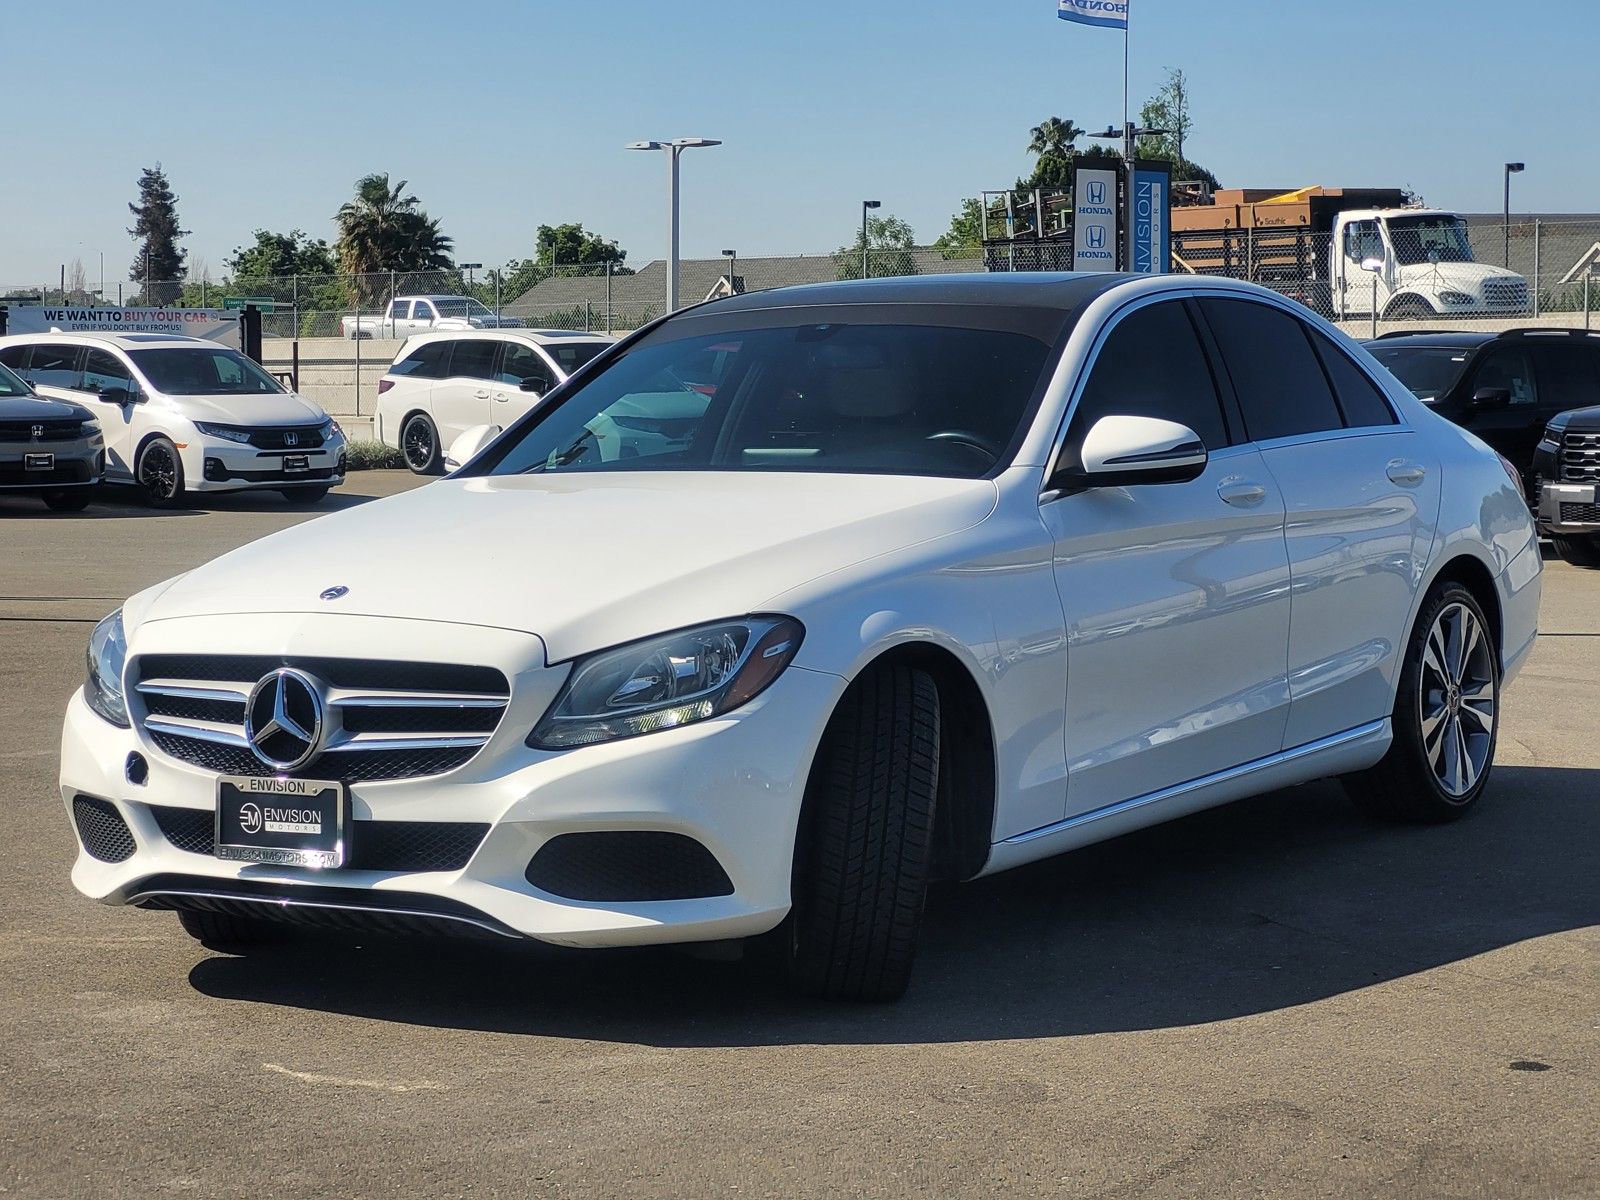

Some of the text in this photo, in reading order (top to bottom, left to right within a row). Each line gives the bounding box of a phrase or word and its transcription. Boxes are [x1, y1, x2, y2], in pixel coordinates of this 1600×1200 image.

[1078, 206, 1113, 215] HONDA
[1138, 181, 1151, 273] NVISION
[1076, 250, 1113, 259] HONDA
[43, 310, 208, 323] WE WANT TO BUY YOUR CAR
[250, 779, 305, 793] ENVISION
[264, 808, 322, 824] ENVISION
[269, 824, 318, 833] MOTORS
[220, 848, 335, 866] ENVISIONMOTORSOM
